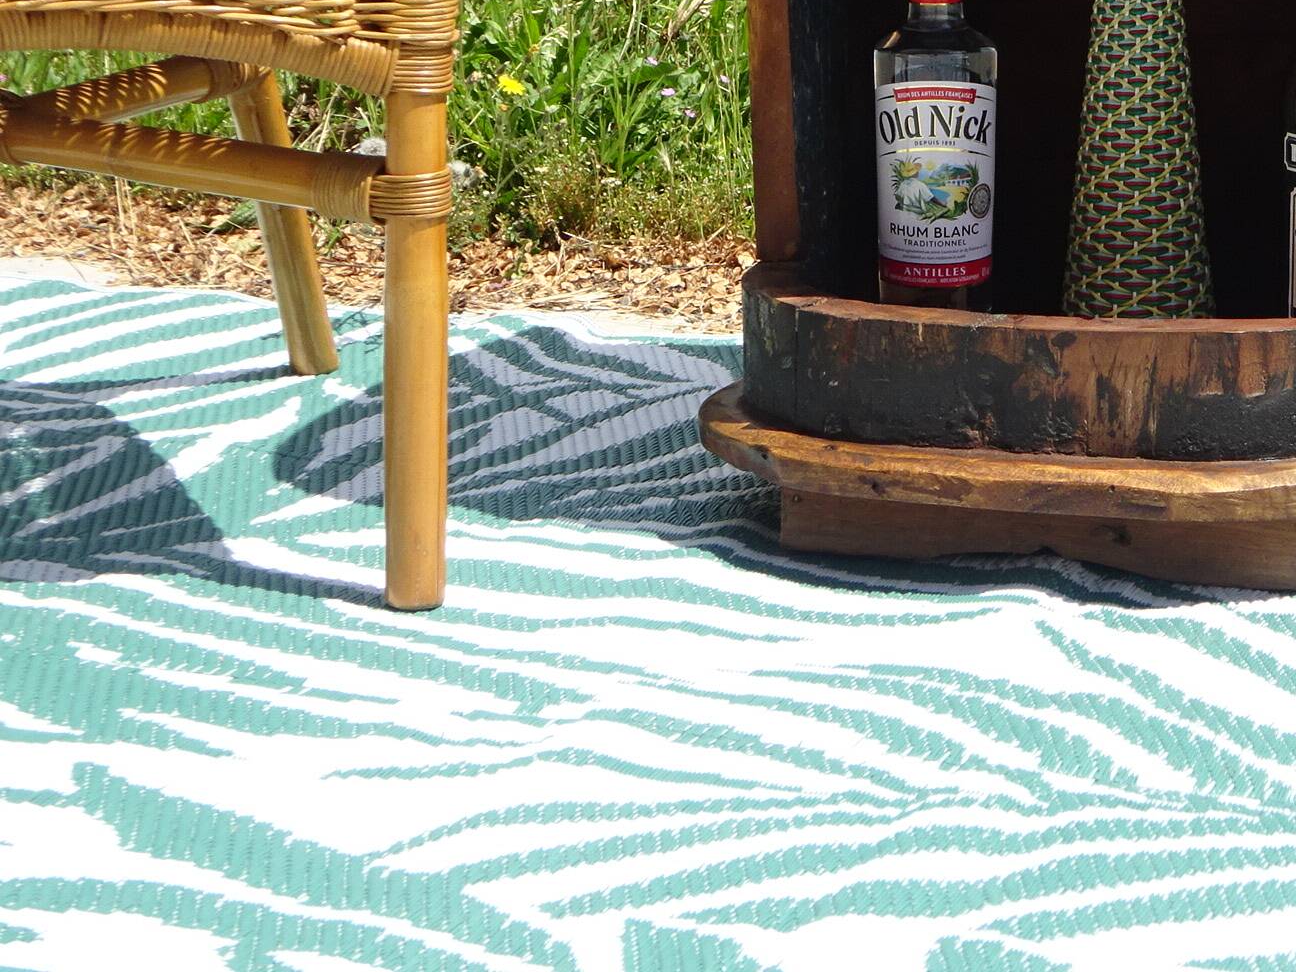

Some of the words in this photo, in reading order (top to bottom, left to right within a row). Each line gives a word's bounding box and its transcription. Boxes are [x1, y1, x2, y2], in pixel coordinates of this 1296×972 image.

[921, 90, 944, 98] ANTILLES
[879, 105, 922, 145] Old
[928, 105, 992, 146] Nick
[914, 139, 940, 147] DEPUIS
[889, 222, 929, 238] RHUM
[934, 222, 979, 239] BLANC
[903, 238, 967, 248] TRADITIONNEL
[903, 266, 967, 278] ANTILLES
